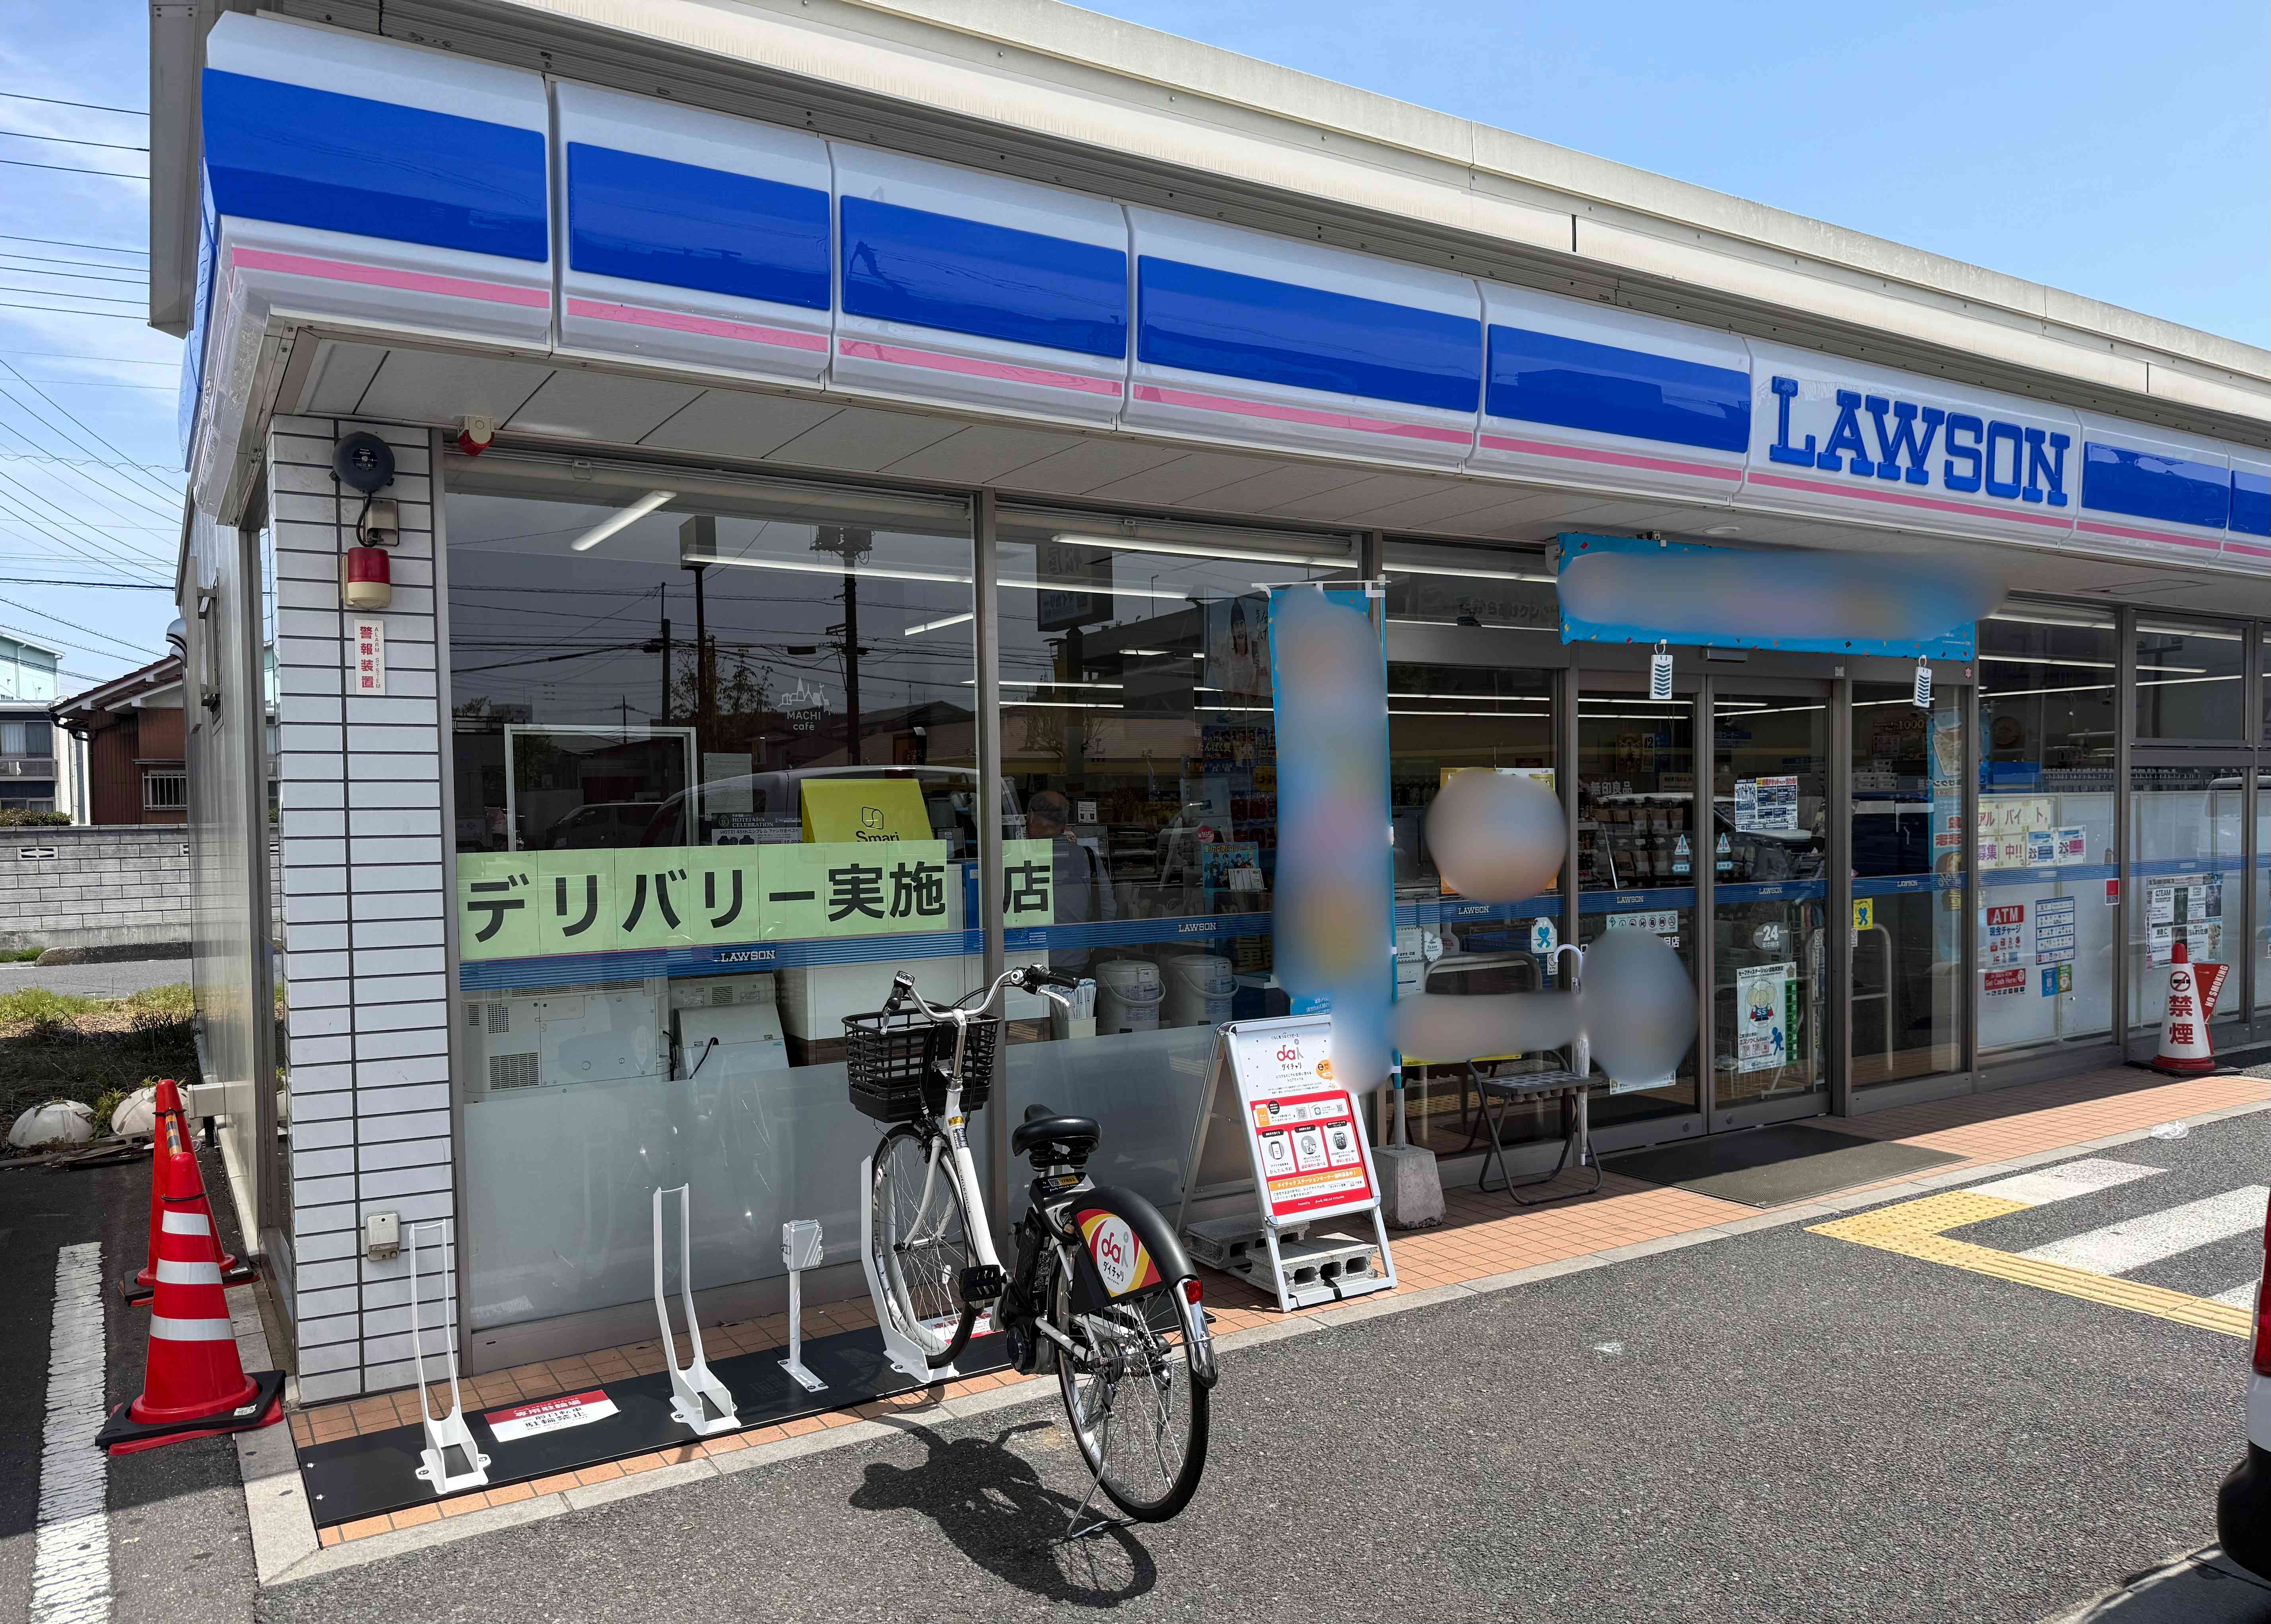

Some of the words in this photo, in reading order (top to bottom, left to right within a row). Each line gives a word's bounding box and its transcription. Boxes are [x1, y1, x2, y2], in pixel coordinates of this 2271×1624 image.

[1770, 376, 2070, 507] LAWSON
[360, 626, 374, 688] 警報装置
[787, 710, 821, 720] MACHI
[793, 721, 815, 731] café
[1590, 780, 1632, 795] 無印良品
[855, 831, 900, 843] Smari
[1458, 906, 1489, 915] LAWSON
[1993, 907, 2018, 924] ATM
[1178, 923, 1216, 932] LAWSON
[1763, 925, 1779, 941] 24
[1989, 925, 2021, 936] 現金チャージ
[721, 950, 775, 963] LAWSON
[2209, 965, 2228, 997] SMOKING
[2205, 997, 2215, 1007] NO
[2169, 995, 2194, 1045] 禁煙
[1103, 1261, 1124, 1282] ダイチャリ
[514, 1399, 582, 1417] 専用駐輪場
[525, 1412, 588, 1428] 駐輪禁止
